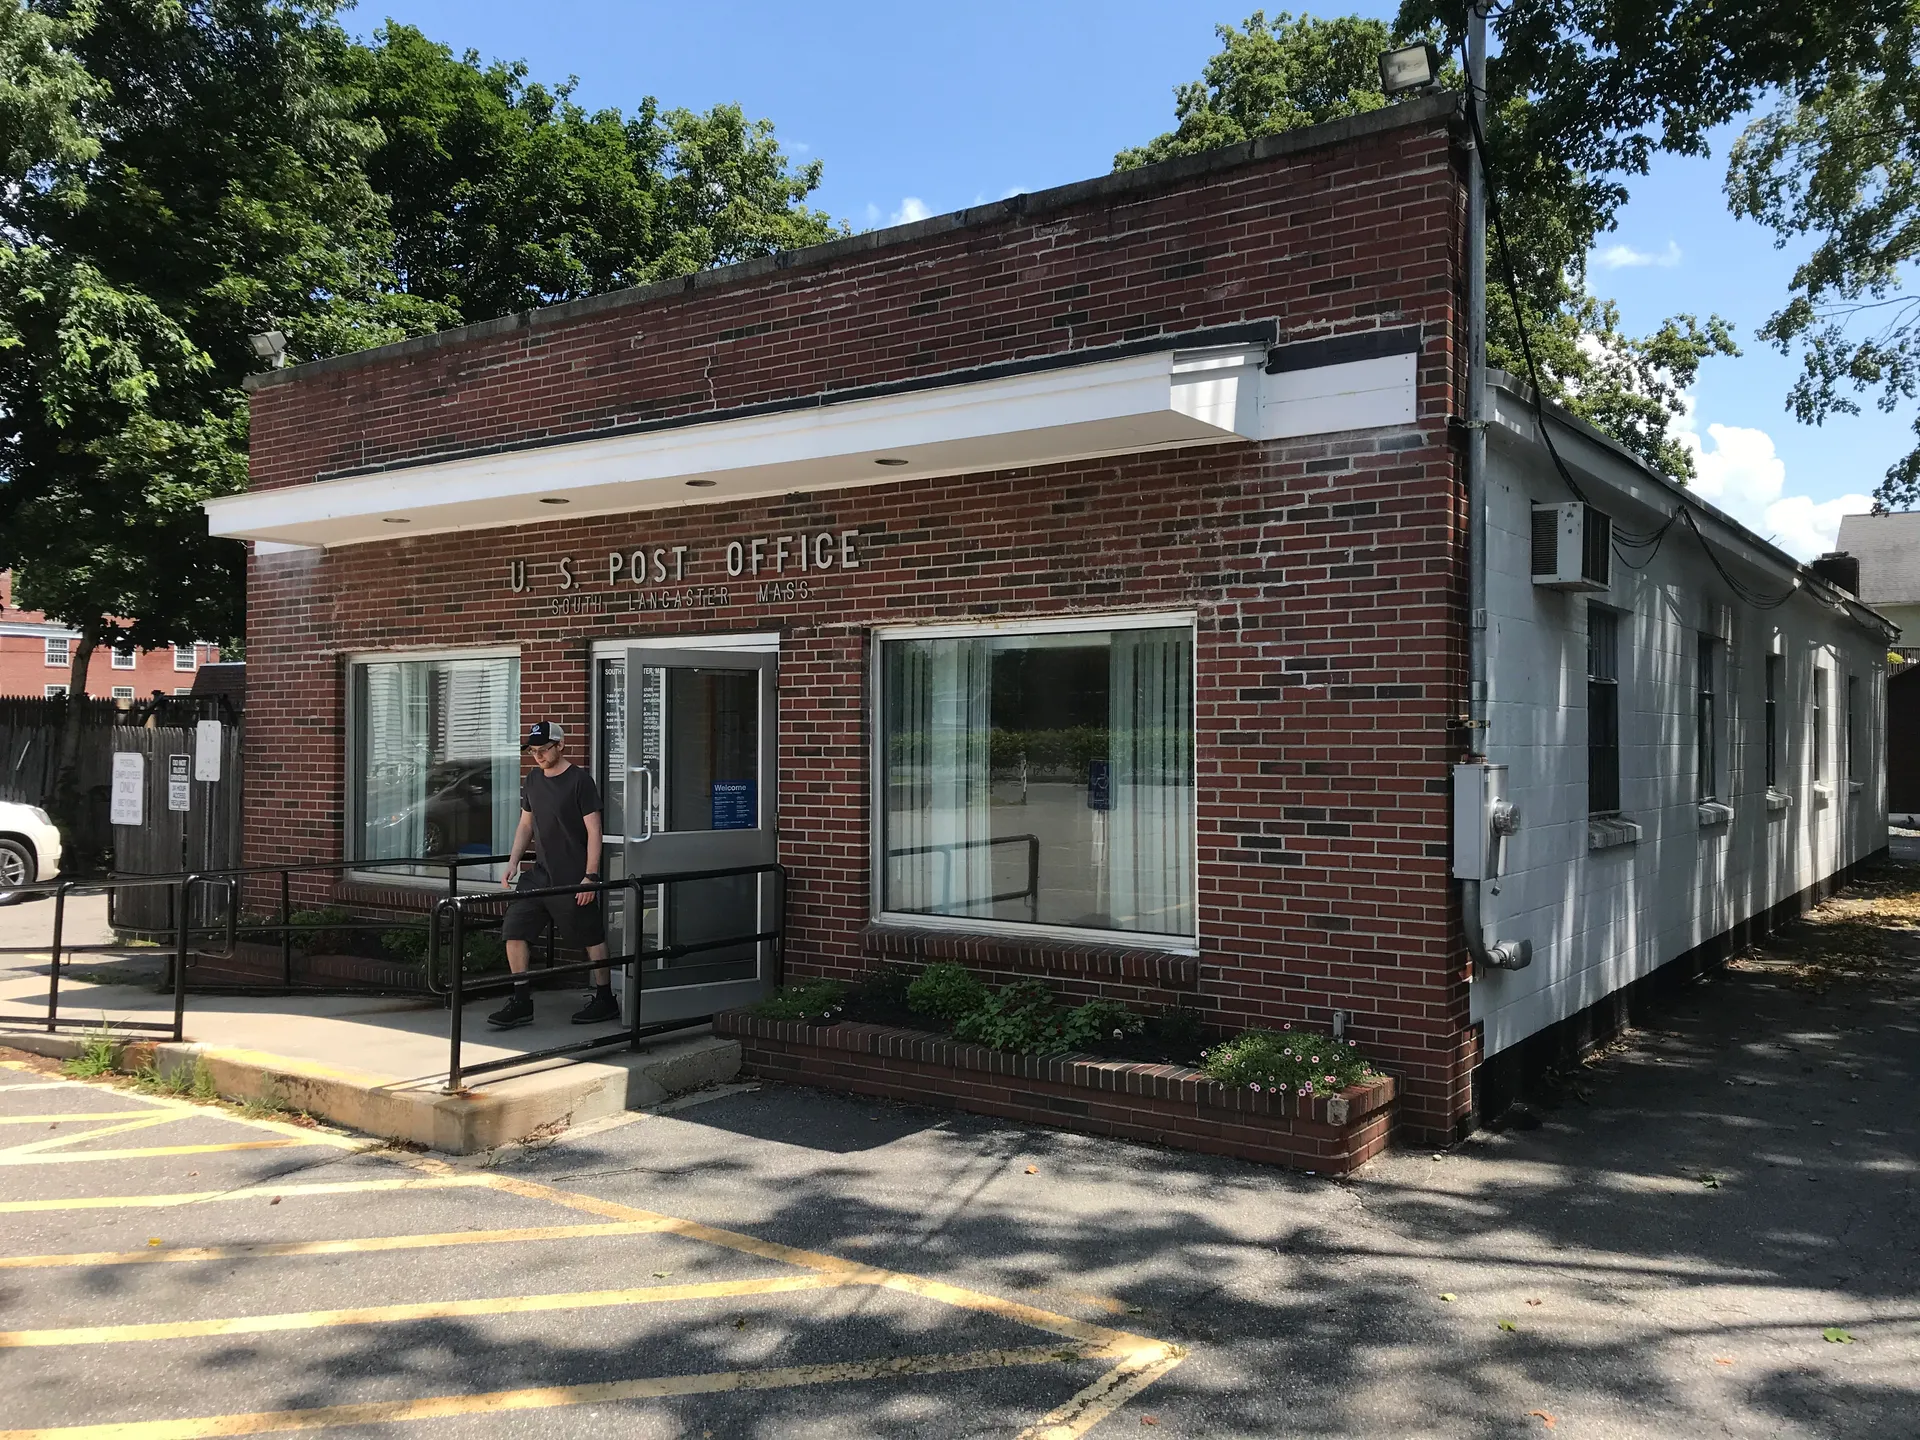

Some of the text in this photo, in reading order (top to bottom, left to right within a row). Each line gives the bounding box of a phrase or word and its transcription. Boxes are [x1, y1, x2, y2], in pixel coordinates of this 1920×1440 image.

[511, 530, 860, 593] U. S. POST OFFICE
[552, 595, 602, 615] SOUTH
[629, 586, 728, 612] LANCASTER
[120, 781, 137, 794] ONLY
[714, 784, 747, 792] Welcome
